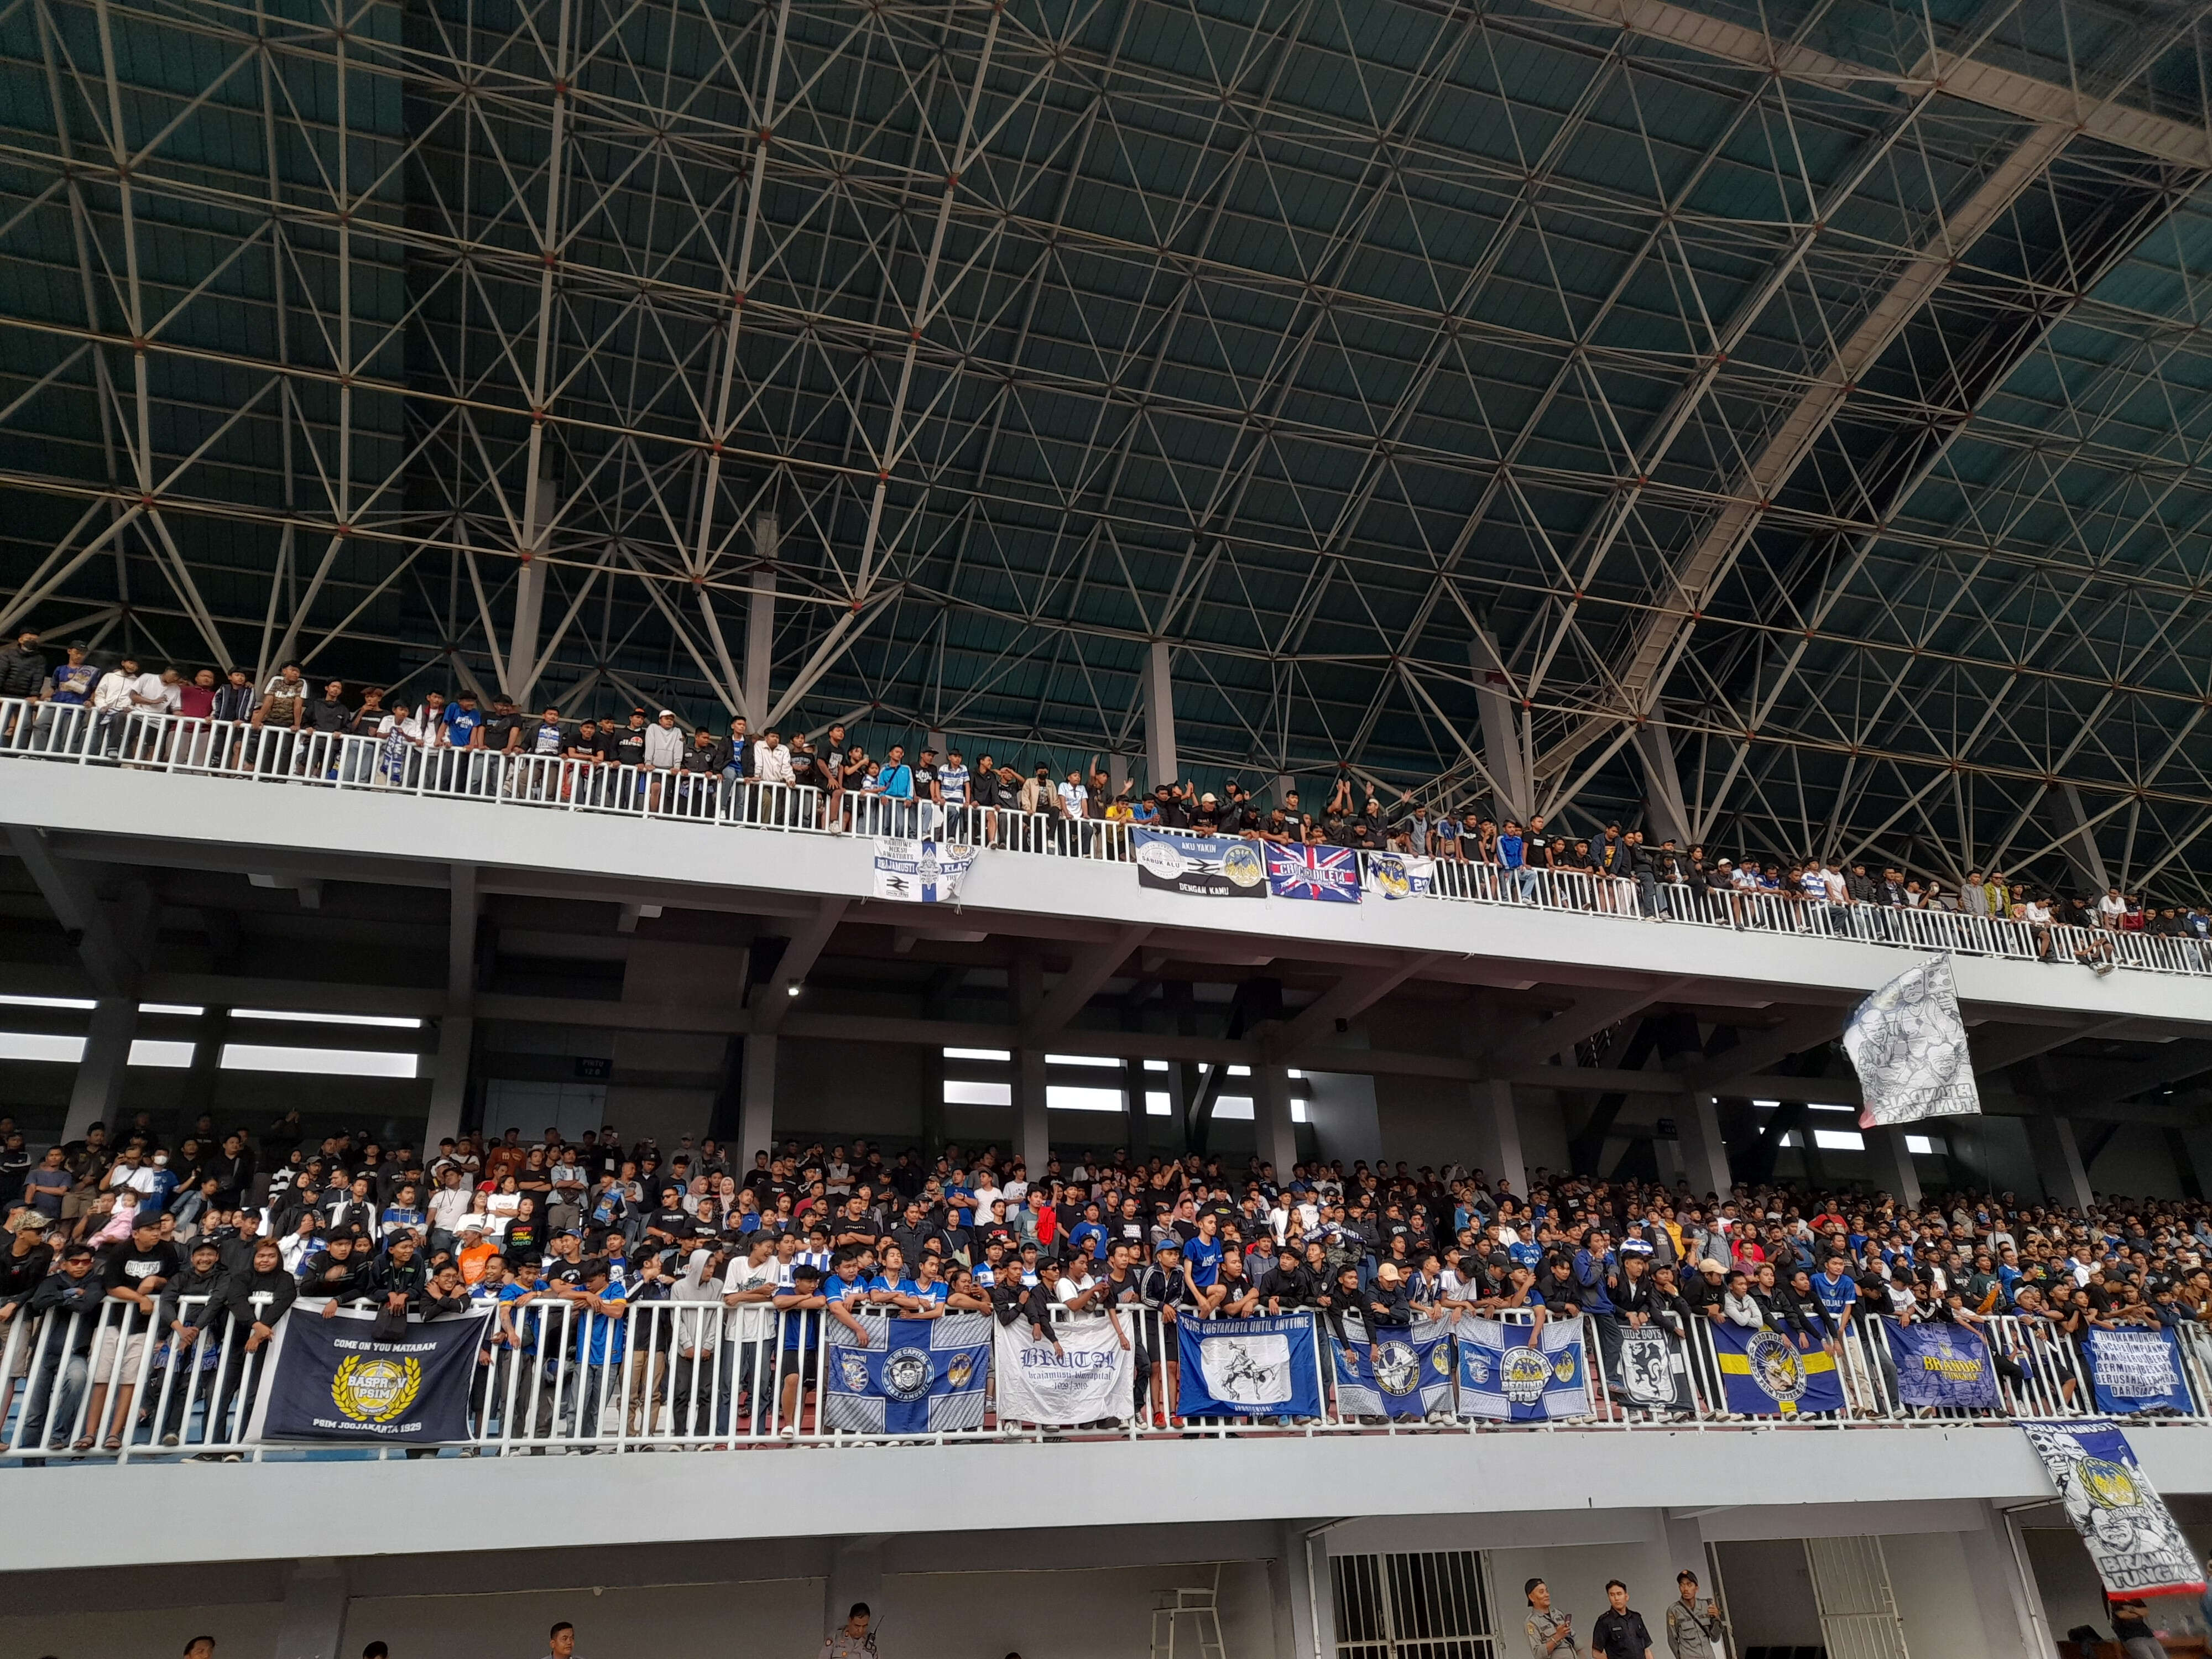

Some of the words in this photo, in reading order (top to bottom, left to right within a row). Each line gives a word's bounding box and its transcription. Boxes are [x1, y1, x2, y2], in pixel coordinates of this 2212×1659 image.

[1182, 842, 1195, 851] AKU
[1197, 843, 1216, 853] YAKIN
[878, 859, 915, 873] BRAJAMUSTI
[1381, 862, 1403, 871] PSIM
[1180, 883, 1207, 895] DENGAN
[1209, 886, 1229, 895] KAMU
[1203, 1321, 1248, 1334] YOGYAKARTA
[1250, 1322, 1272, 1332] UNTIL
[1275, 1317, 1309, 1330] ANYTIME
[1642, 1329, 1662, 1339] BOYS
[2117, 1333, 2138, 1342] KAMU
[334, 1339, 358, 1350] COME
[359, 1342, 371, 1351] ON
[373, 1343, 392, 1352] YOU
[392, 1342, 437, 1353] MATARAM
[887, 1351, 902, 1365] BLUE
[902, 1349, 928, 1364] CAPITAL
[1020, 1348, 1116, 1370] BRUTAL
[2096, 1374, 2142, 1385] BERUSAHA
[887, 1384, 928, 1400] BRAJAMUSTI
[1759, 1379, 1773, 1394] PSIM
[2112, 1386, 2134, 1396] DARI
[359, 1389, 390, 1399] PSIM
[313, 1418, 336, 1428] PSIM
[400, 1422, 421, 1432] 1929
[2022, 1422, 2120, 1434] BRAJAMUSTI
